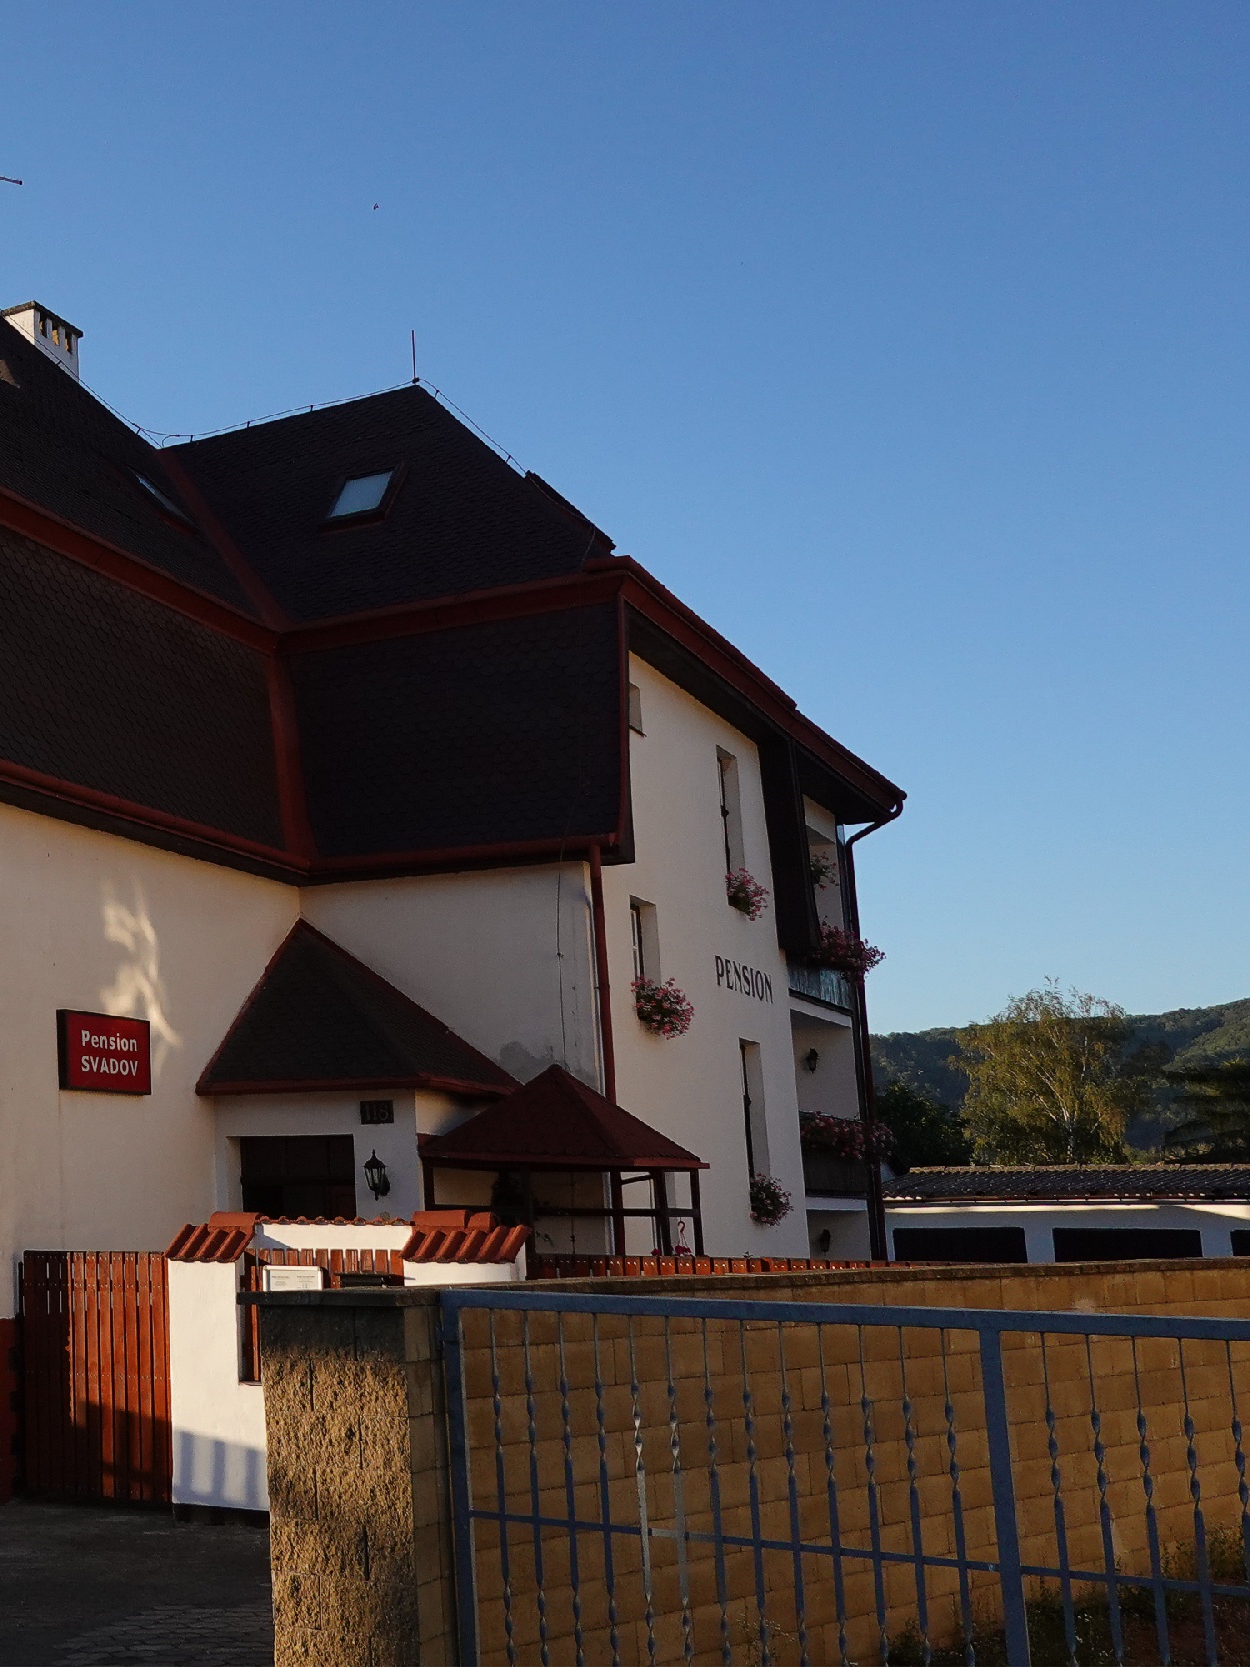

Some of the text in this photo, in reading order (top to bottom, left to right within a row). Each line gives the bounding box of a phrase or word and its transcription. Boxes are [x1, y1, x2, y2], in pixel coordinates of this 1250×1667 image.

[714, 955, 774, 1004] PENSION
[81, 1029, 138, 1052] Pension
[81, 1055, 138, 1077] SVADOV
